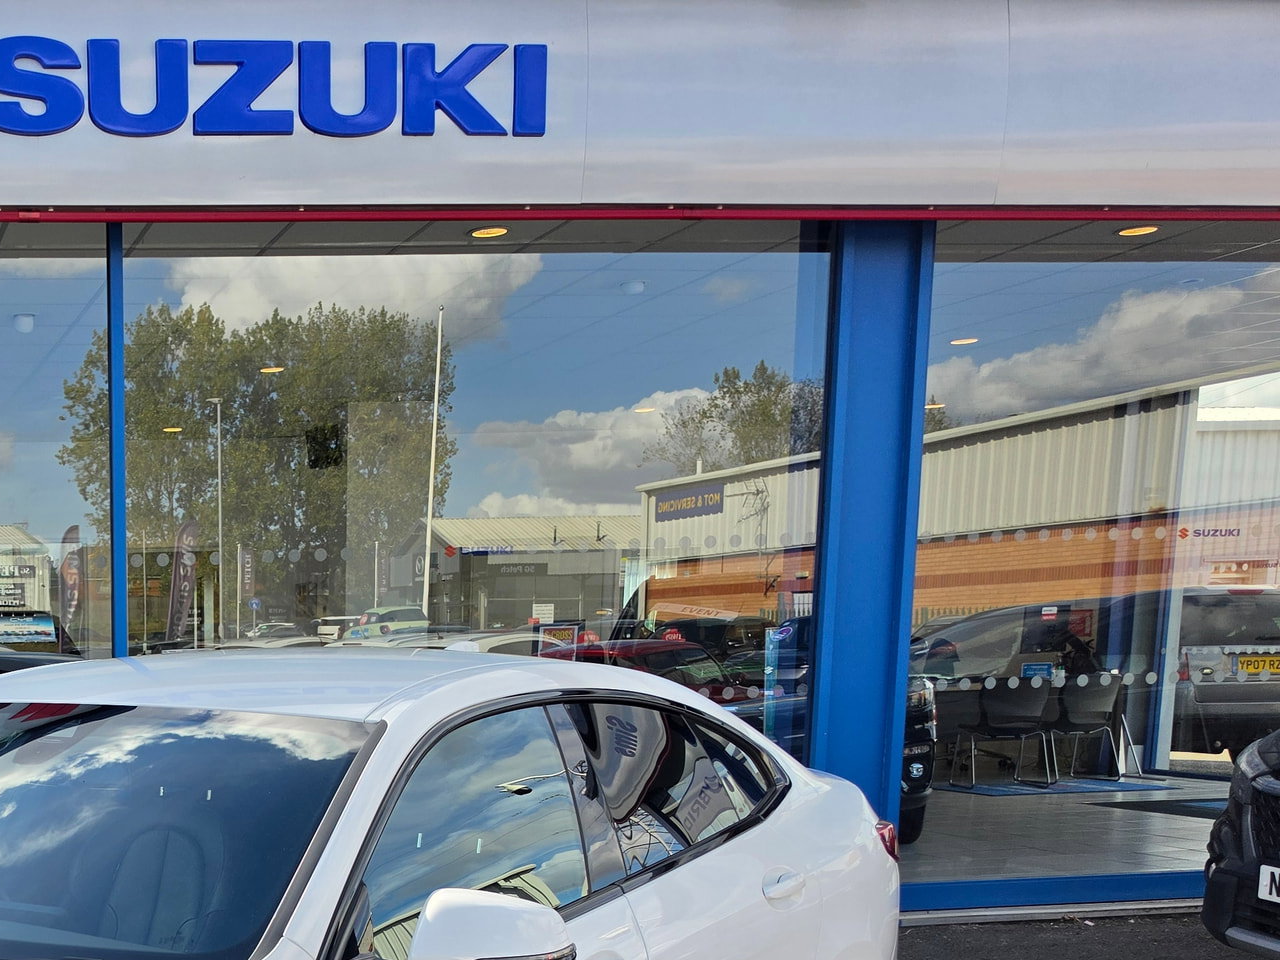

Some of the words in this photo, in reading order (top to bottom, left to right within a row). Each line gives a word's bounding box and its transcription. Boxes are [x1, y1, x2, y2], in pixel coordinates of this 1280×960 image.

[1193, 528, 1240, 537] SUZUKI
[681, 606, 722, 617] EVENT
[1240, 660, 1267, 670] YP07
